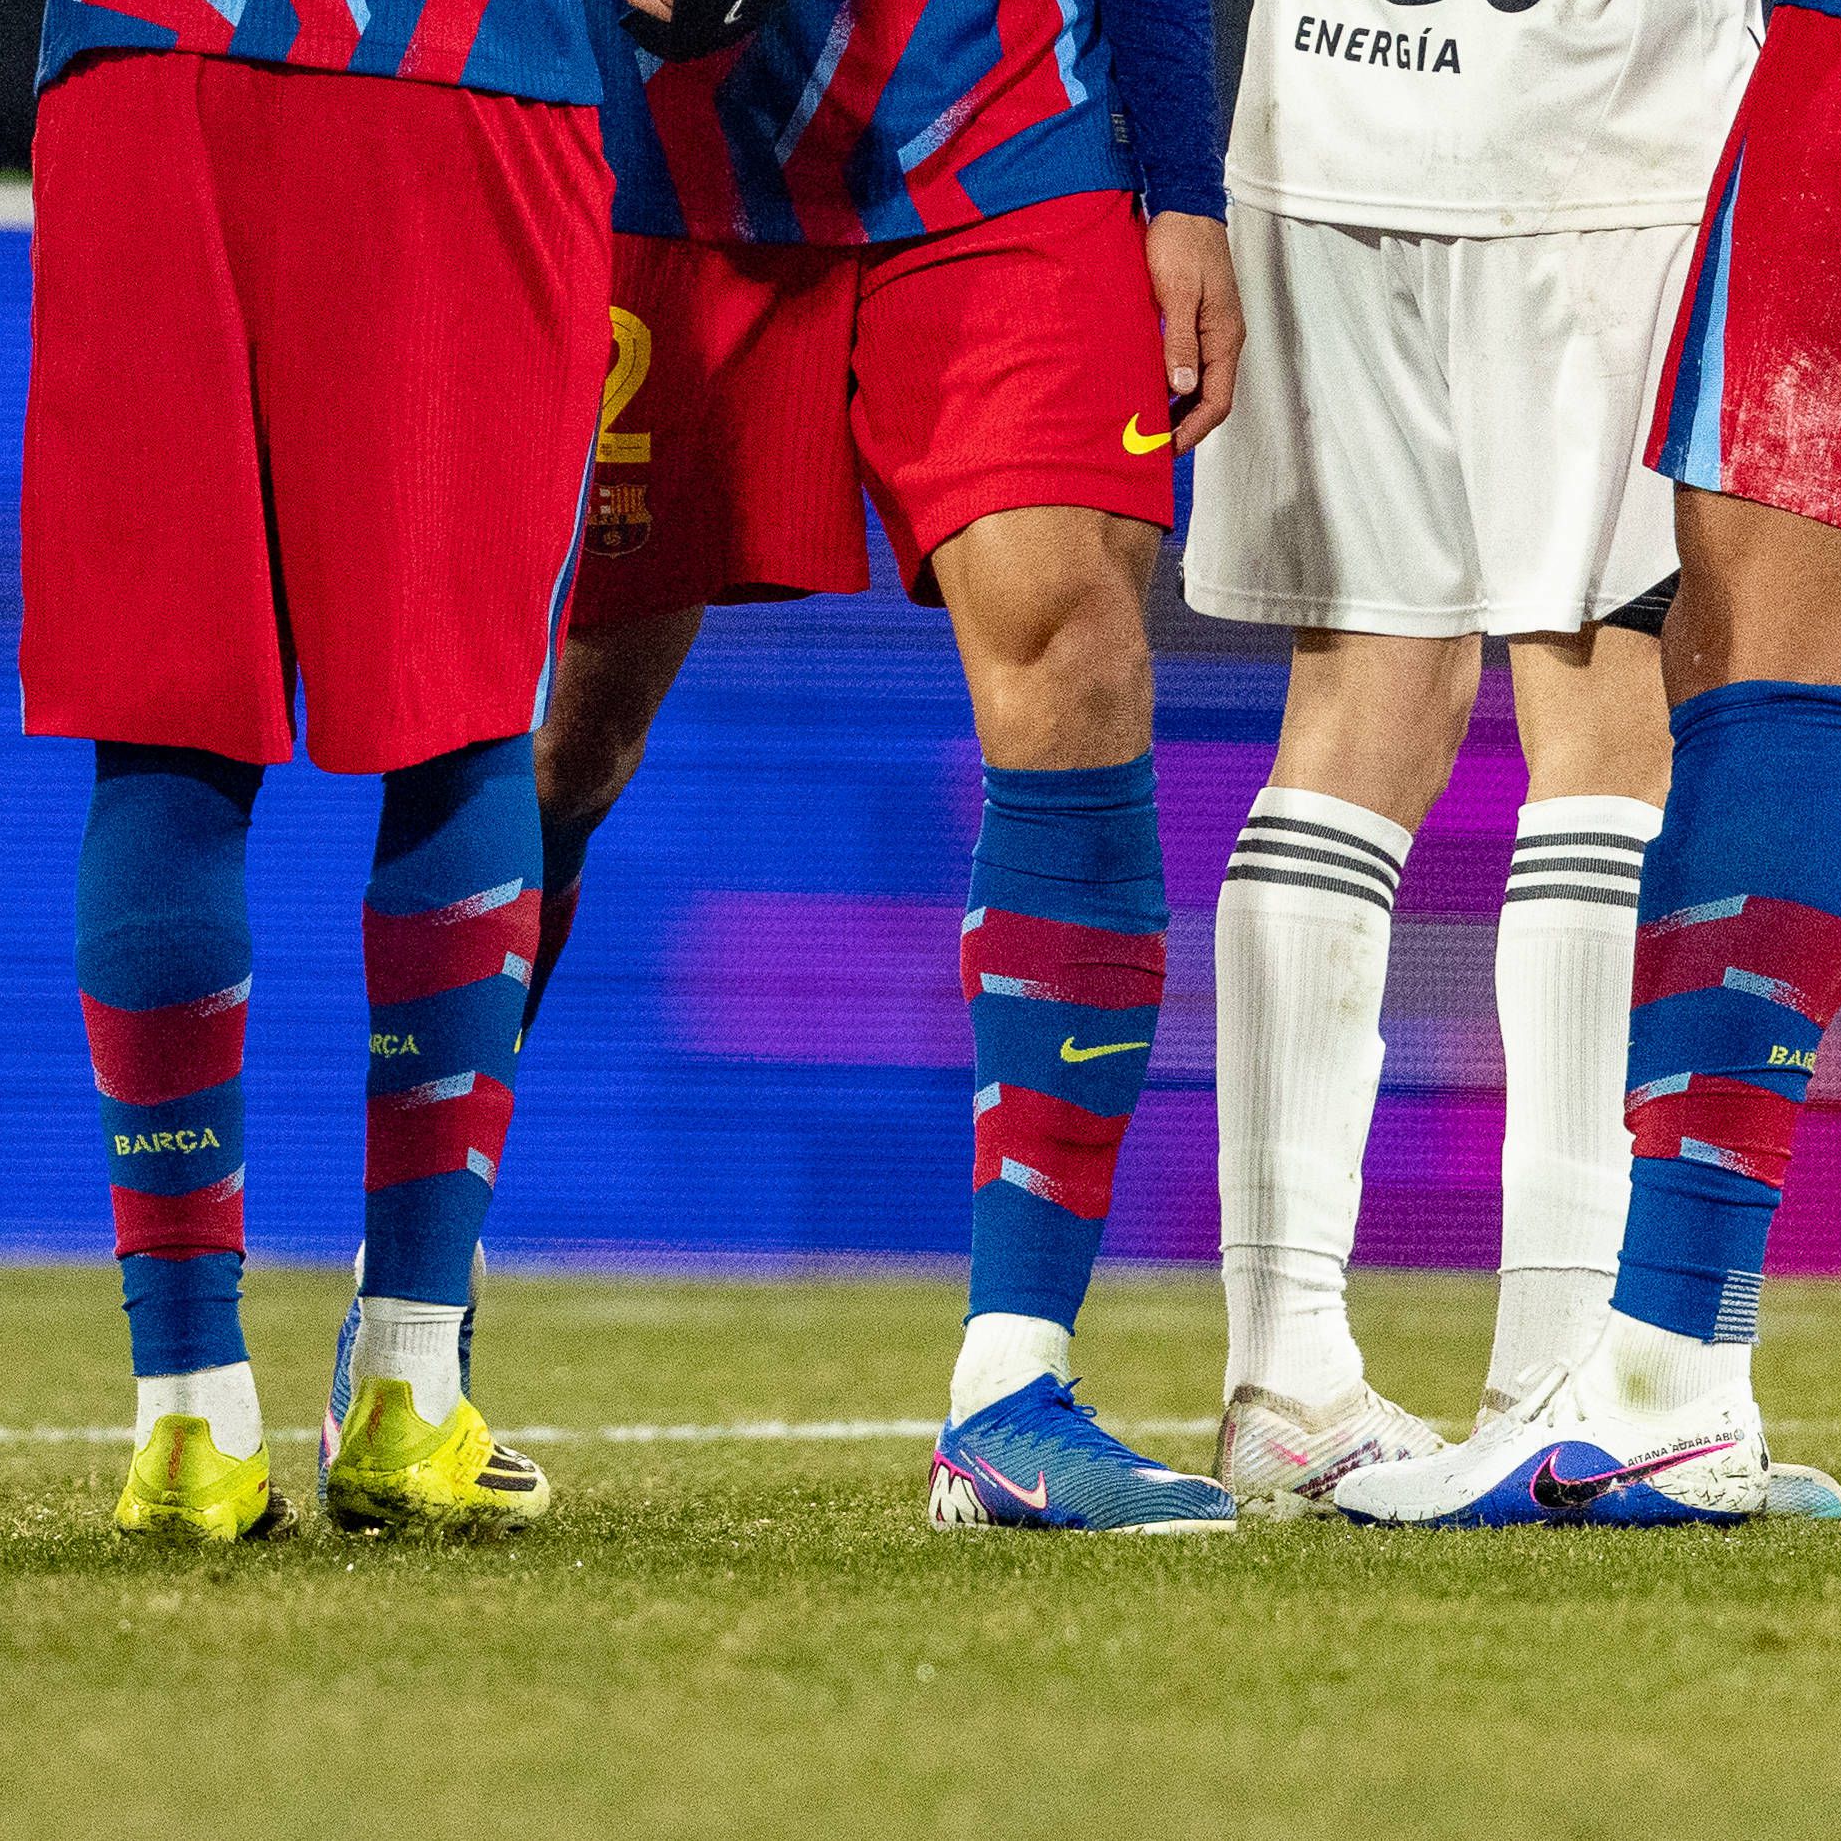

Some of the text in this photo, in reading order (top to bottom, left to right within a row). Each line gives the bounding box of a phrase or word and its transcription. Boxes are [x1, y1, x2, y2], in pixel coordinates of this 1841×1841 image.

[1294, 15, 1461, 74] ENERGÍA
[114, 1127, 220, 1155] BARÇA
[1627, 1447, 1669, 1467] AITANA
